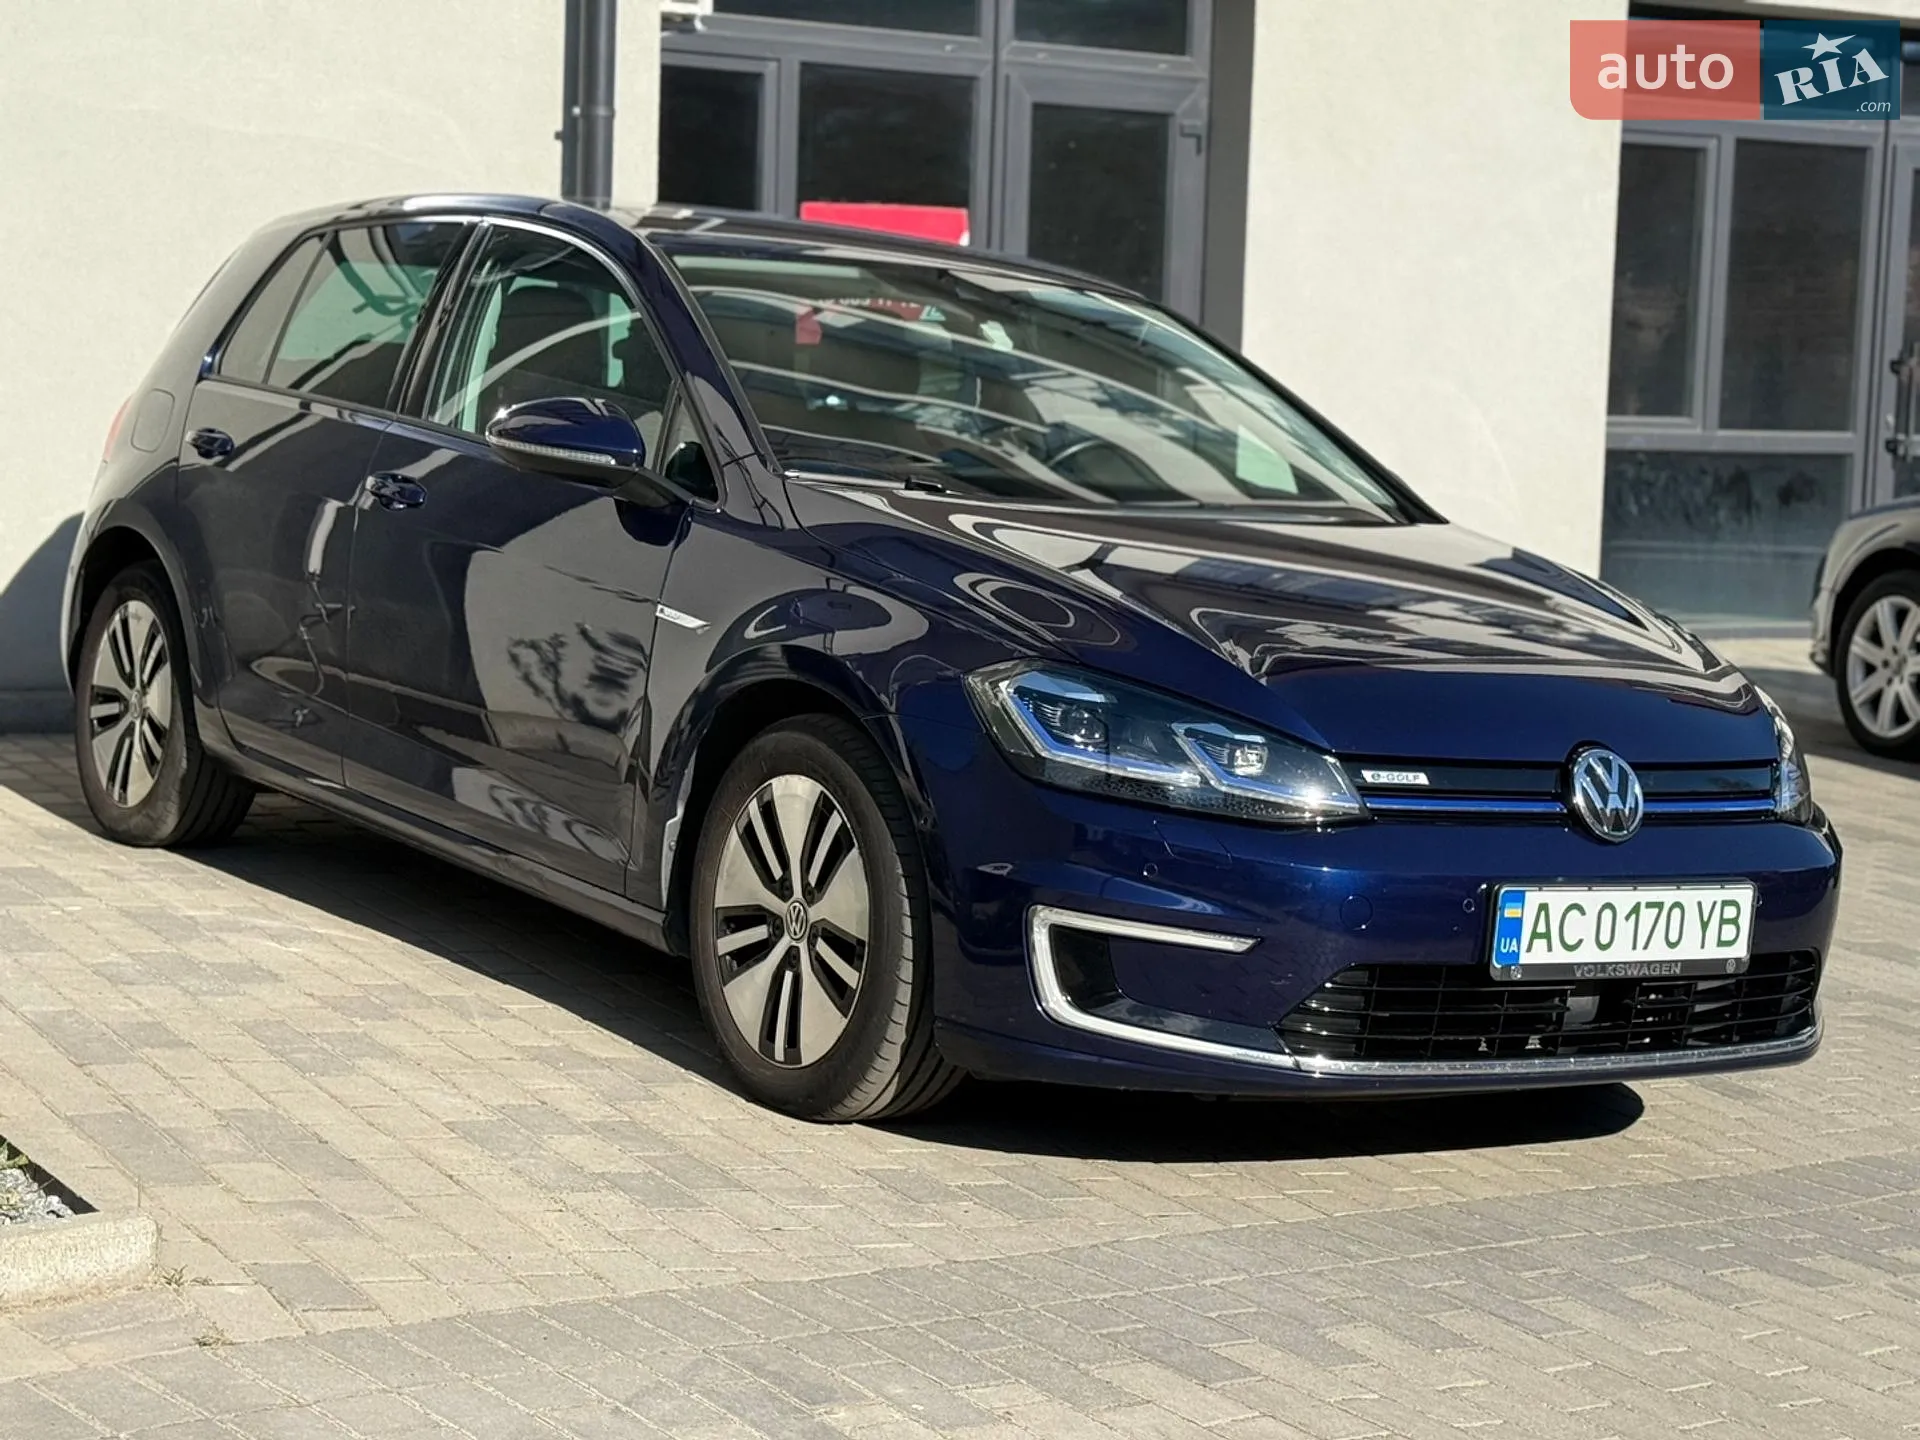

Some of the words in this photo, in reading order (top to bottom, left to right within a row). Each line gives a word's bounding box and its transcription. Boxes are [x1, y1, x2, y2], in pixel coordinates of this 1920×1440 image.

[1526, 902, 1587, 953] AC
[1595, 901, 1685, 951] 0170
[1697, 899, 1741, 949] YB
[1500, 937, 1519, 953] UA
[1573, 961, 1682, 978] VOLKSWAGEN
